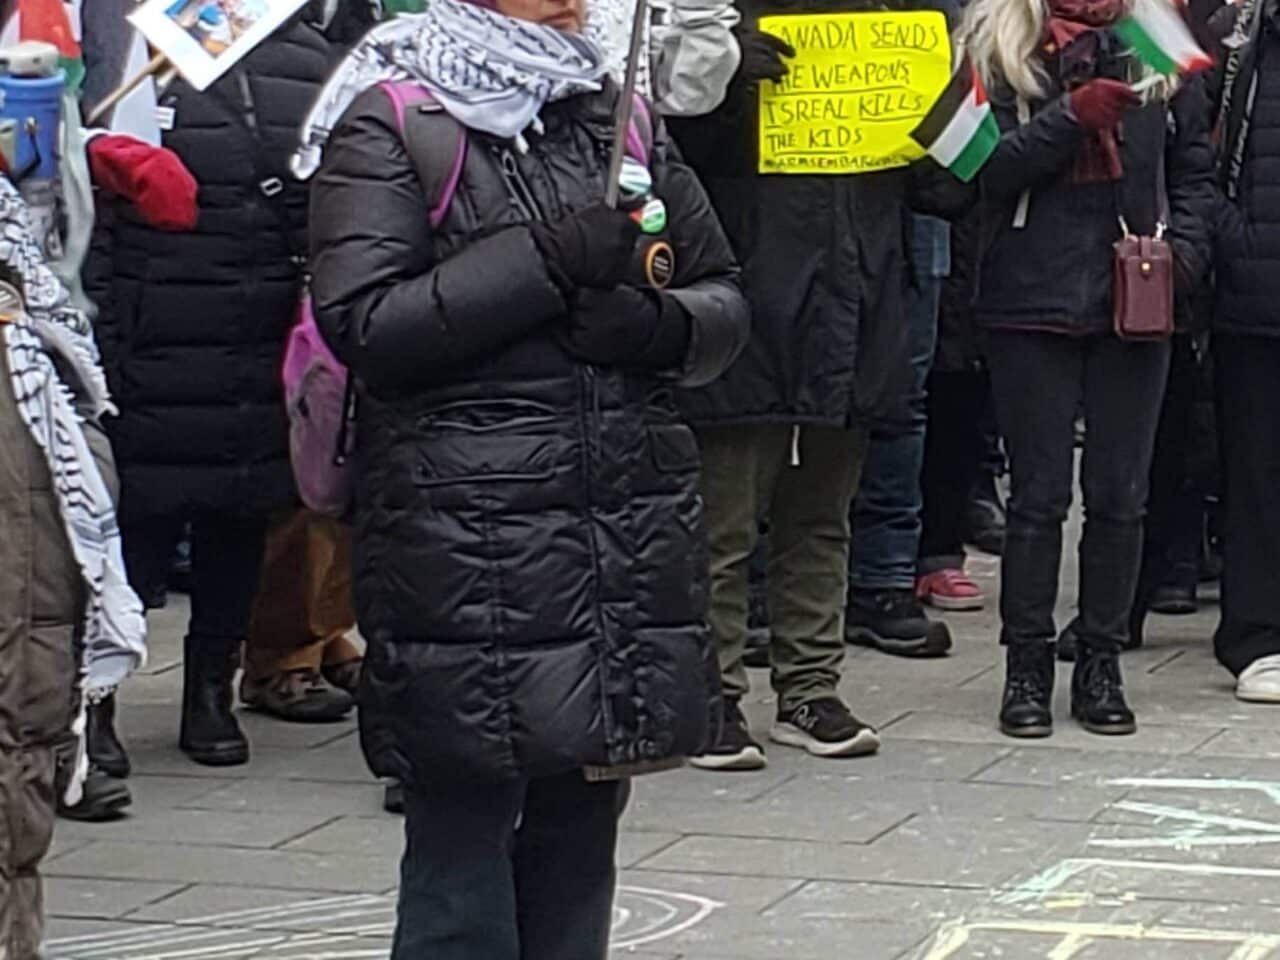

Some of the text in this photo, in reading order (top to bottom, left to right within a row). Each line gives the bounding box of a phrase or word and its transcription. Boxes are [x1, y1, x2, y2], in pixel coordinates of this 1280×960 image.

[871, 19, 939, 50] SENDS
[812, 59, 911, 89] WEAPONS
[858, 93, 922, 117] KILLS
[764, 126, 863, 153] THE KIDS
